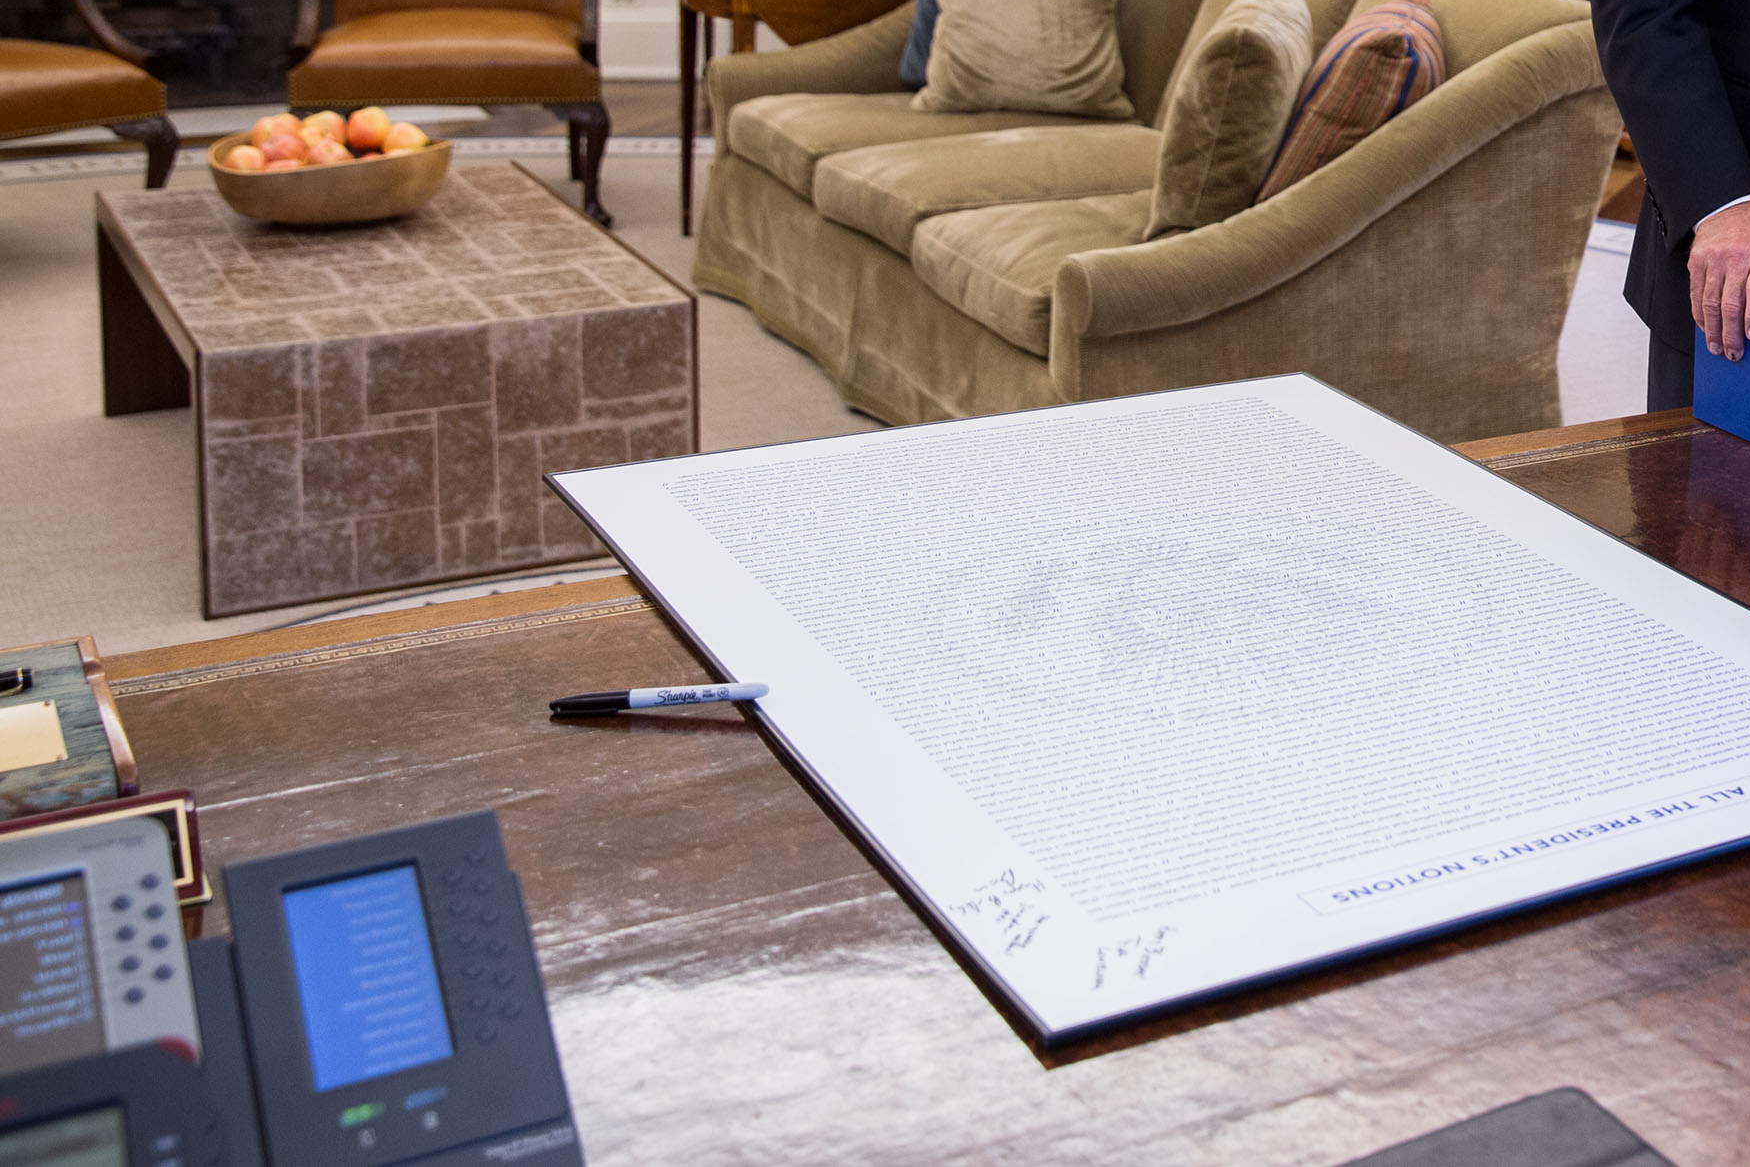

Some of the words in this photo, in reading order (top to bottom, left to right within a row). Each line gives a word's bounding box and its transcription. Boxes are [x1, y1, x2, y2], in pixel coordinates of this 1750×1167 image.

[1699, 785, 1745, 803] ALL
[1645, 800, 1699, 819] THE
[1472, 815, 1642, 865] PRESIDENT'S
[1332, 861, 1466, 903] NOTIONS
